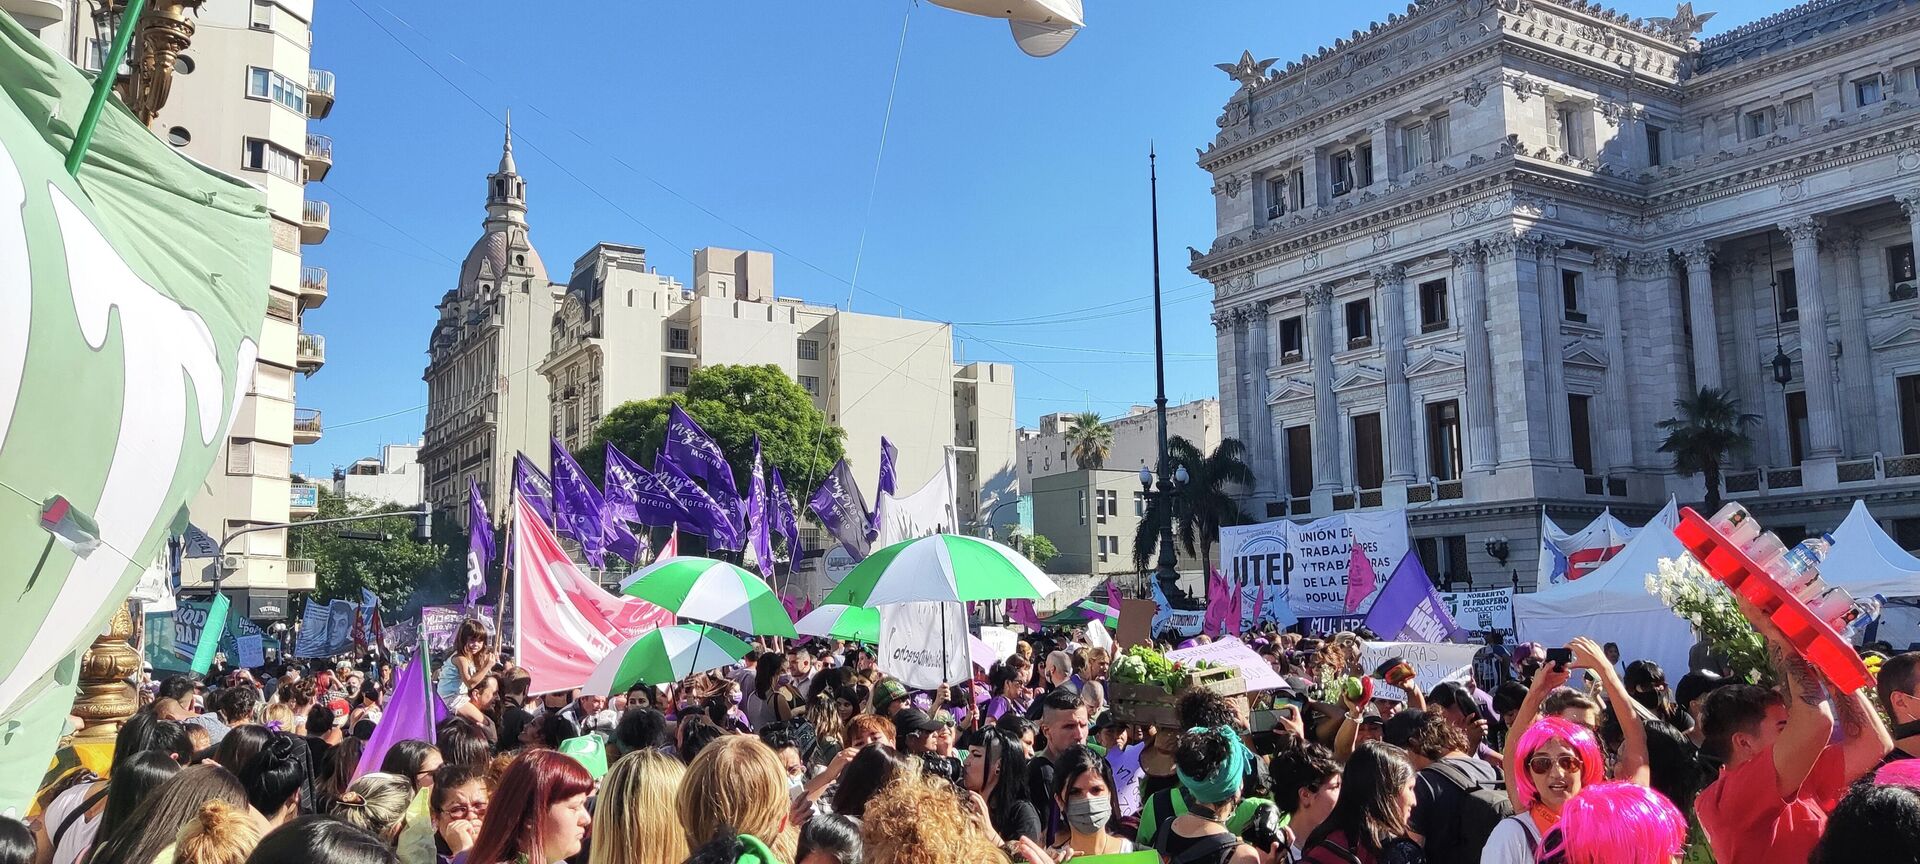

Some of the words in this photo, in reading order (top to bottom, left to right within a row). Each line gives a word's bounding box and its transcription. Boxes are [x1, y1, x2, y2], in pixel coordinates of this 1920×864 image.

[691, 448, 722, 469] Moreno
[831, 504, 850, 530] Moreno
[1299, 529, 1336, 543] UNIÓN
[1341, 527, 1353, 538] DE
[1300, 541, 1378, 558] TRABAJRES
[1233, 552, 1294, 588] UTEP
[1301, 563, 1308, 573] Y
[1310, 557, 1391, 573] TRABARAS
[1304, 577, 1318, 588] DE
[1321, 576, 1337, 588] LA
[1306, 591, 1344, 603] POPUL
[1462, 599, 1470, 607] DI
[1472, 596, 1509, 606] PROSPERO
[1466, 590, 1506, 599] NORBERTO
